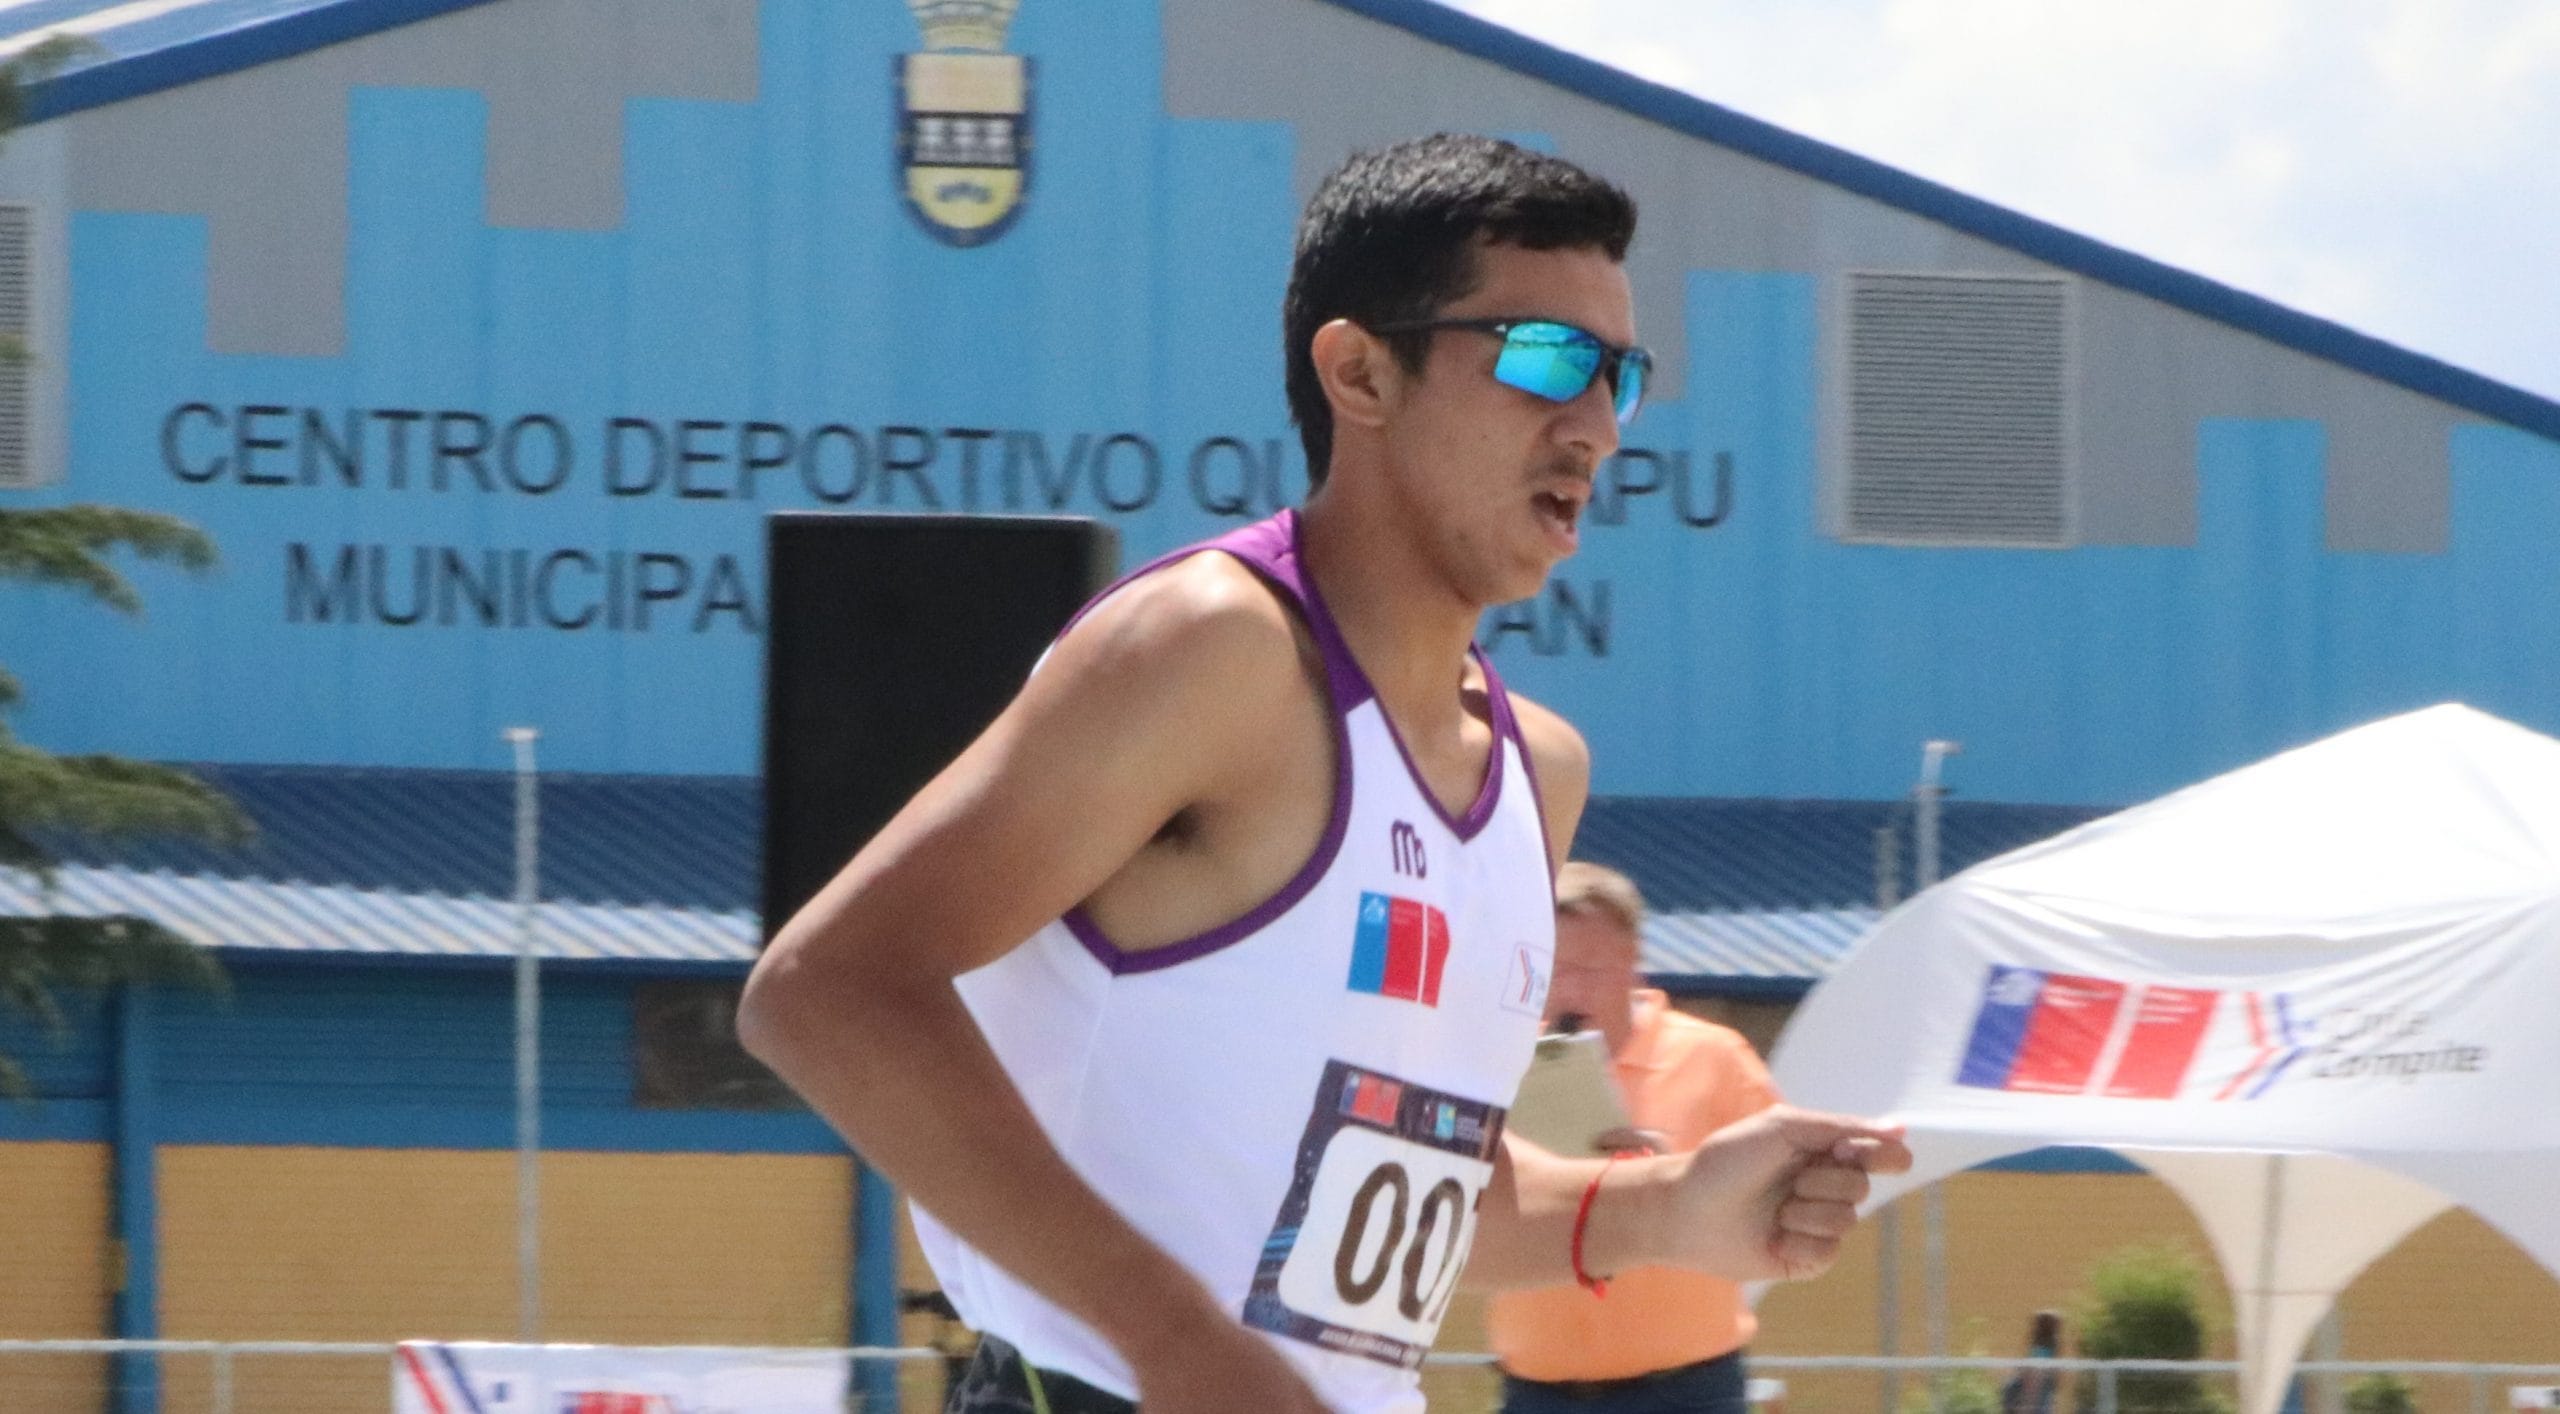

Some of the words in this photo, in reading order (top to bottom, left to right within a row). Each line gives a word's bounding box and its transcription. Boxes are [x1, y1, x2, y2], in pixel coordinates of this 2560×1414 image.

[160, 402, 577, 495] CENTRO
[604, 416, 1163, 513] DEPORTIVO
[284, 542, 765, 633] MUNICIPA
